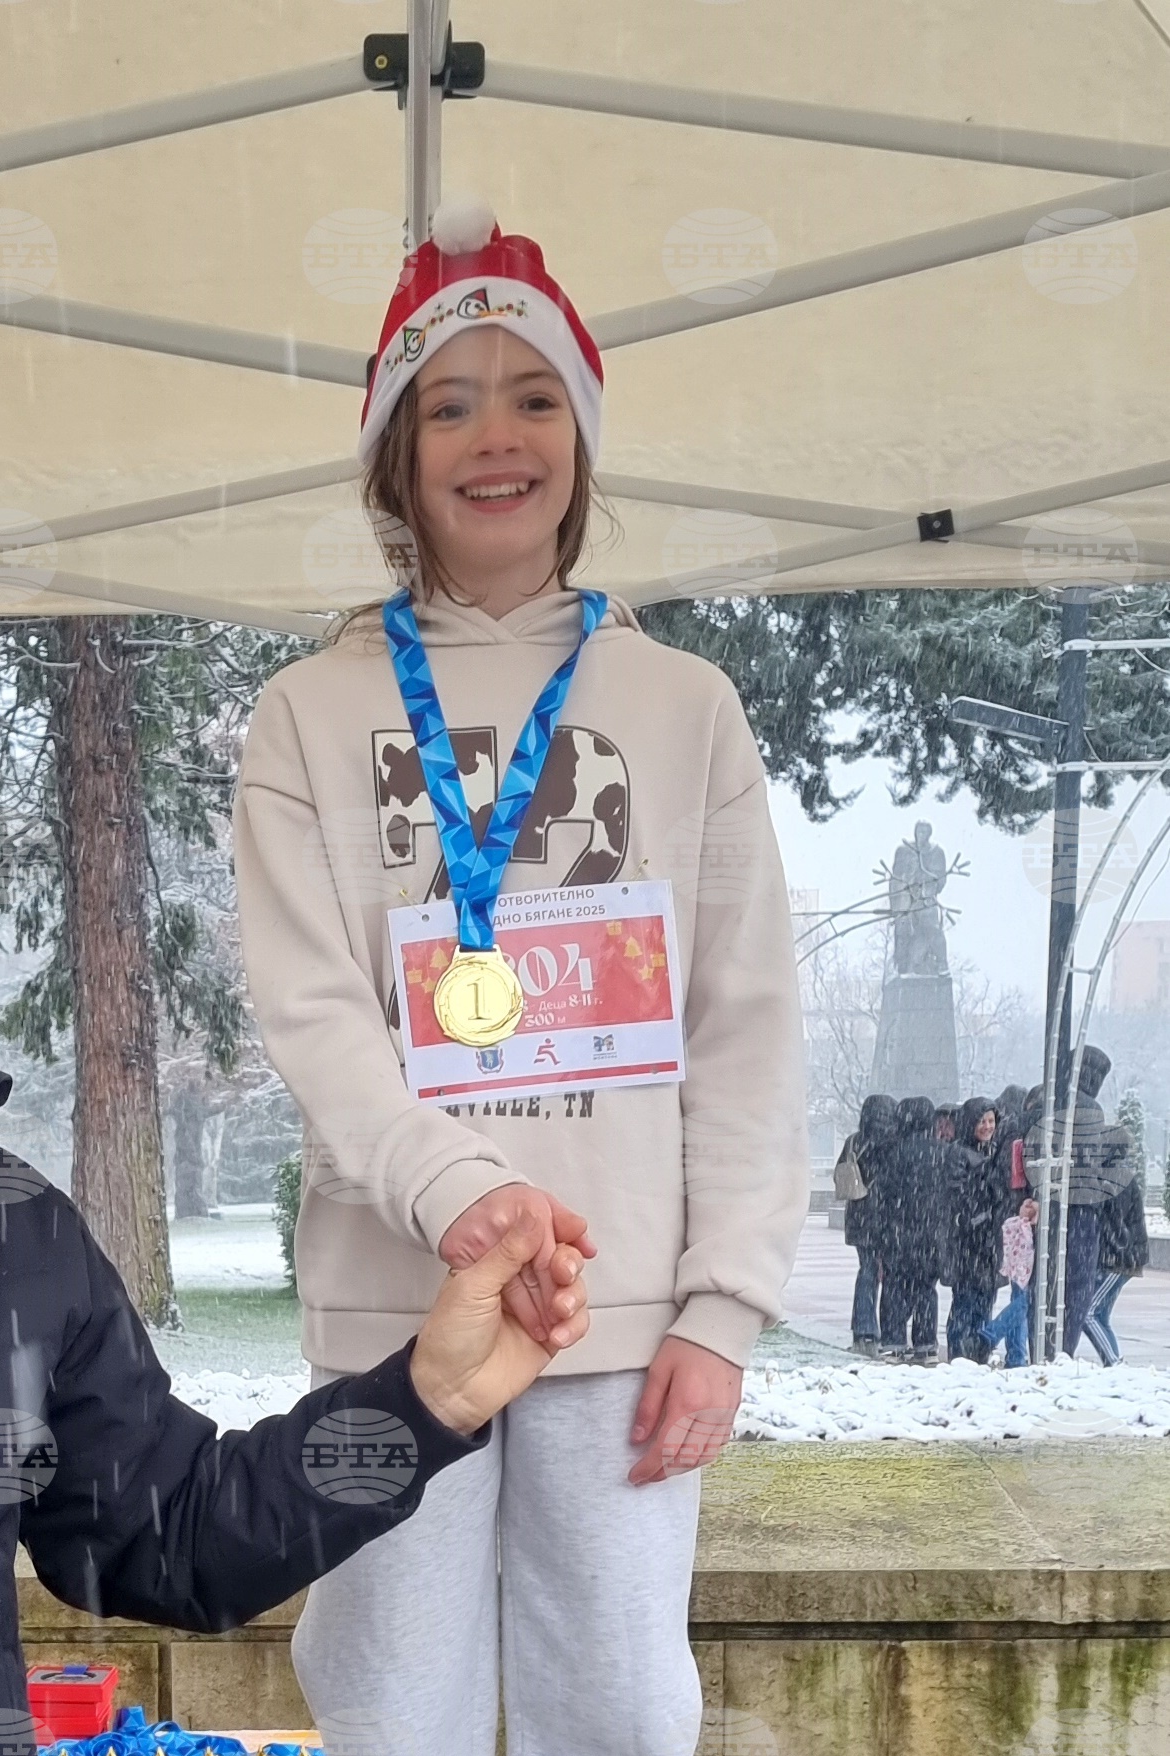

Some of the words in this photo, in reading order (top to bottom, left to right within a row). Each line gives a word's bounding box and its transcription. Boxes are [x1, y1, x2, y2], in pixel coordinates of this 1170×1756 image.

[498, 888, 595, 908] ОТВОРИТЕЛНО
[493, 912, 521, 928] ДНО
[525, 908, 573, 923] БЯГАНЕ
[576, 904, 606, 918] 2025
[502, 943, 597, 997] 04
[467, 976, 492, 1021] 1
[563, 1089, 595, 1118] TN
